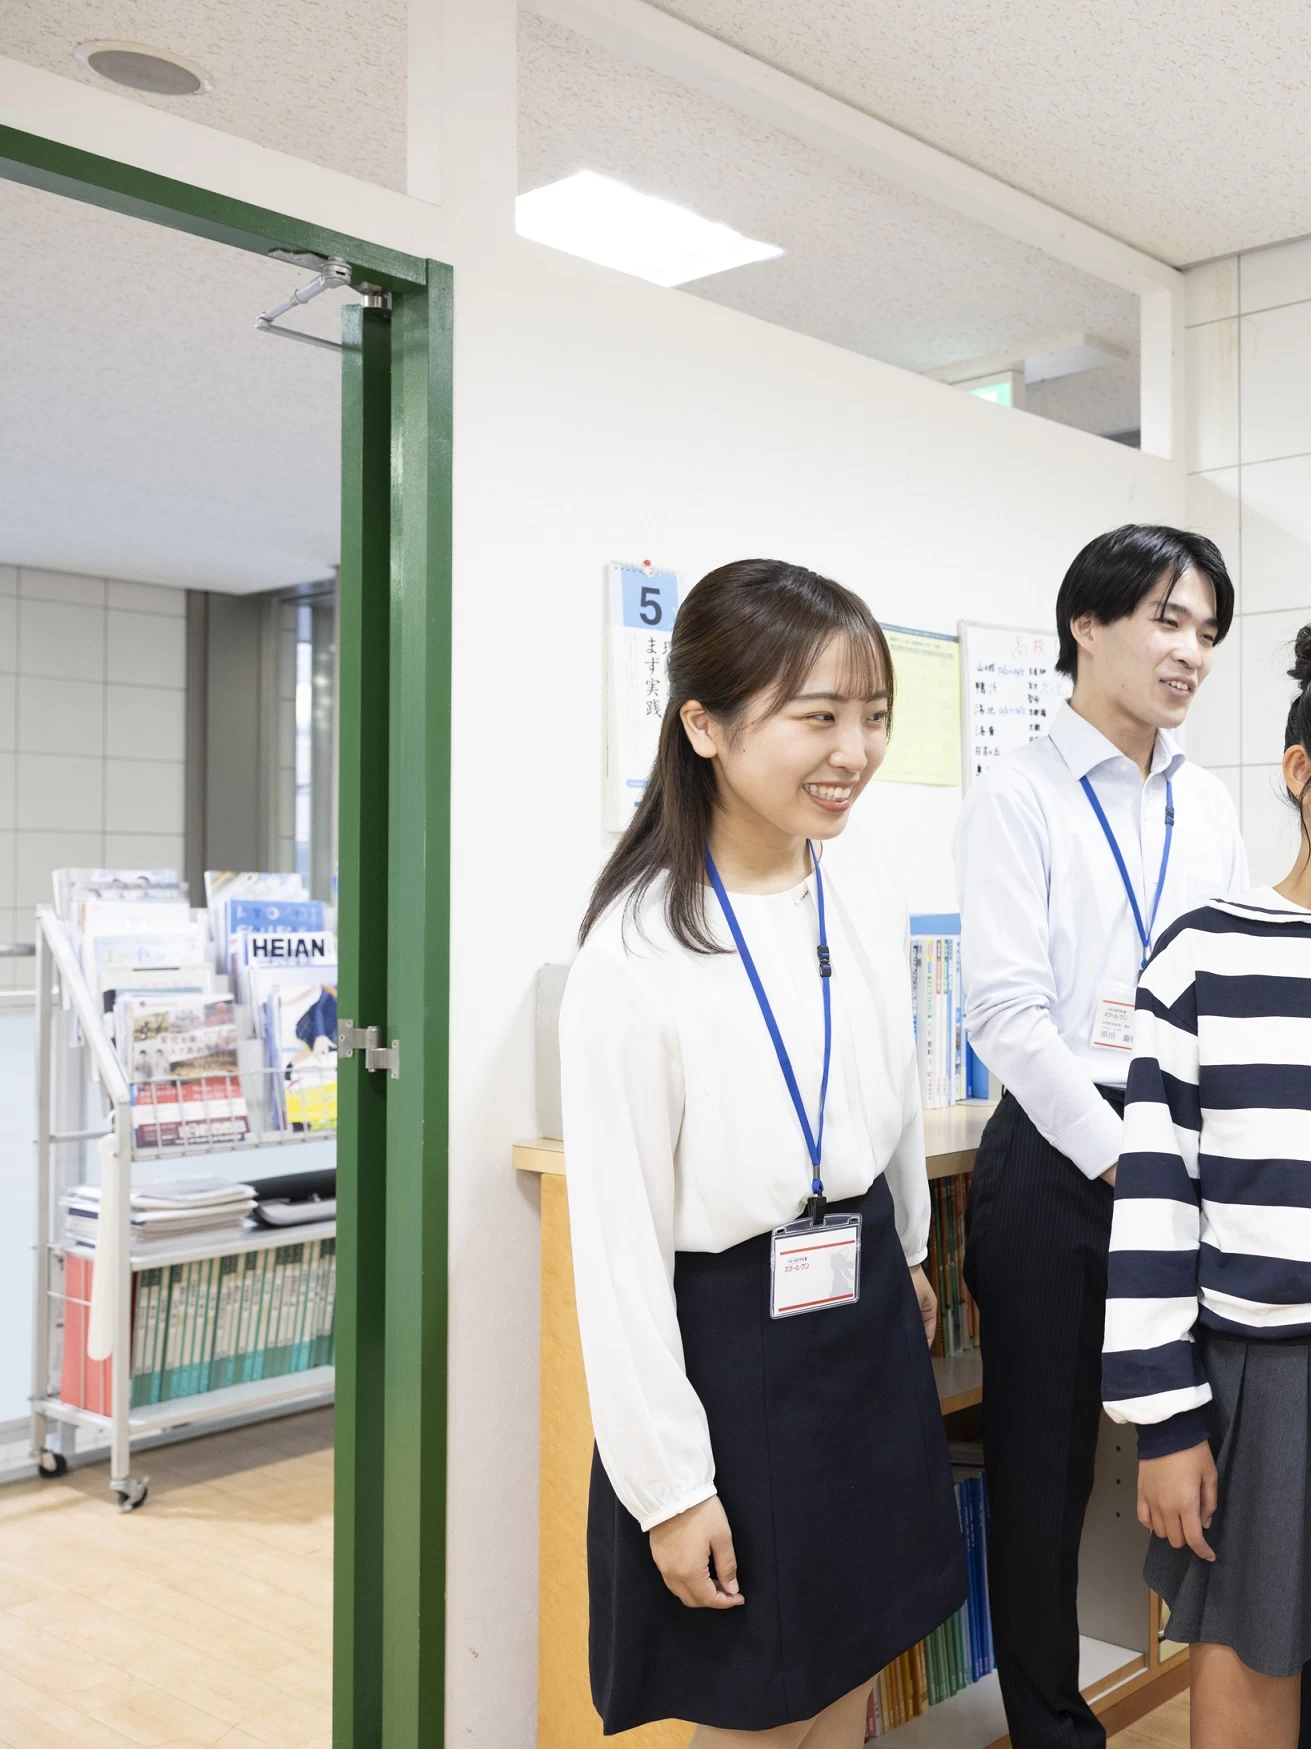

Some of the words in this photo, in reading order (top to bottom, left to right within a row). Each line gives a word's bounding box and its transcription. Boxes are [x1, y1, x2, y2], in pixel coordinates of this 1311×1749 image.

[639, 586, 663, 625] 5
[644, 637, 662, 718] まず実践
[252, 938, 325, 958] HEIAN
